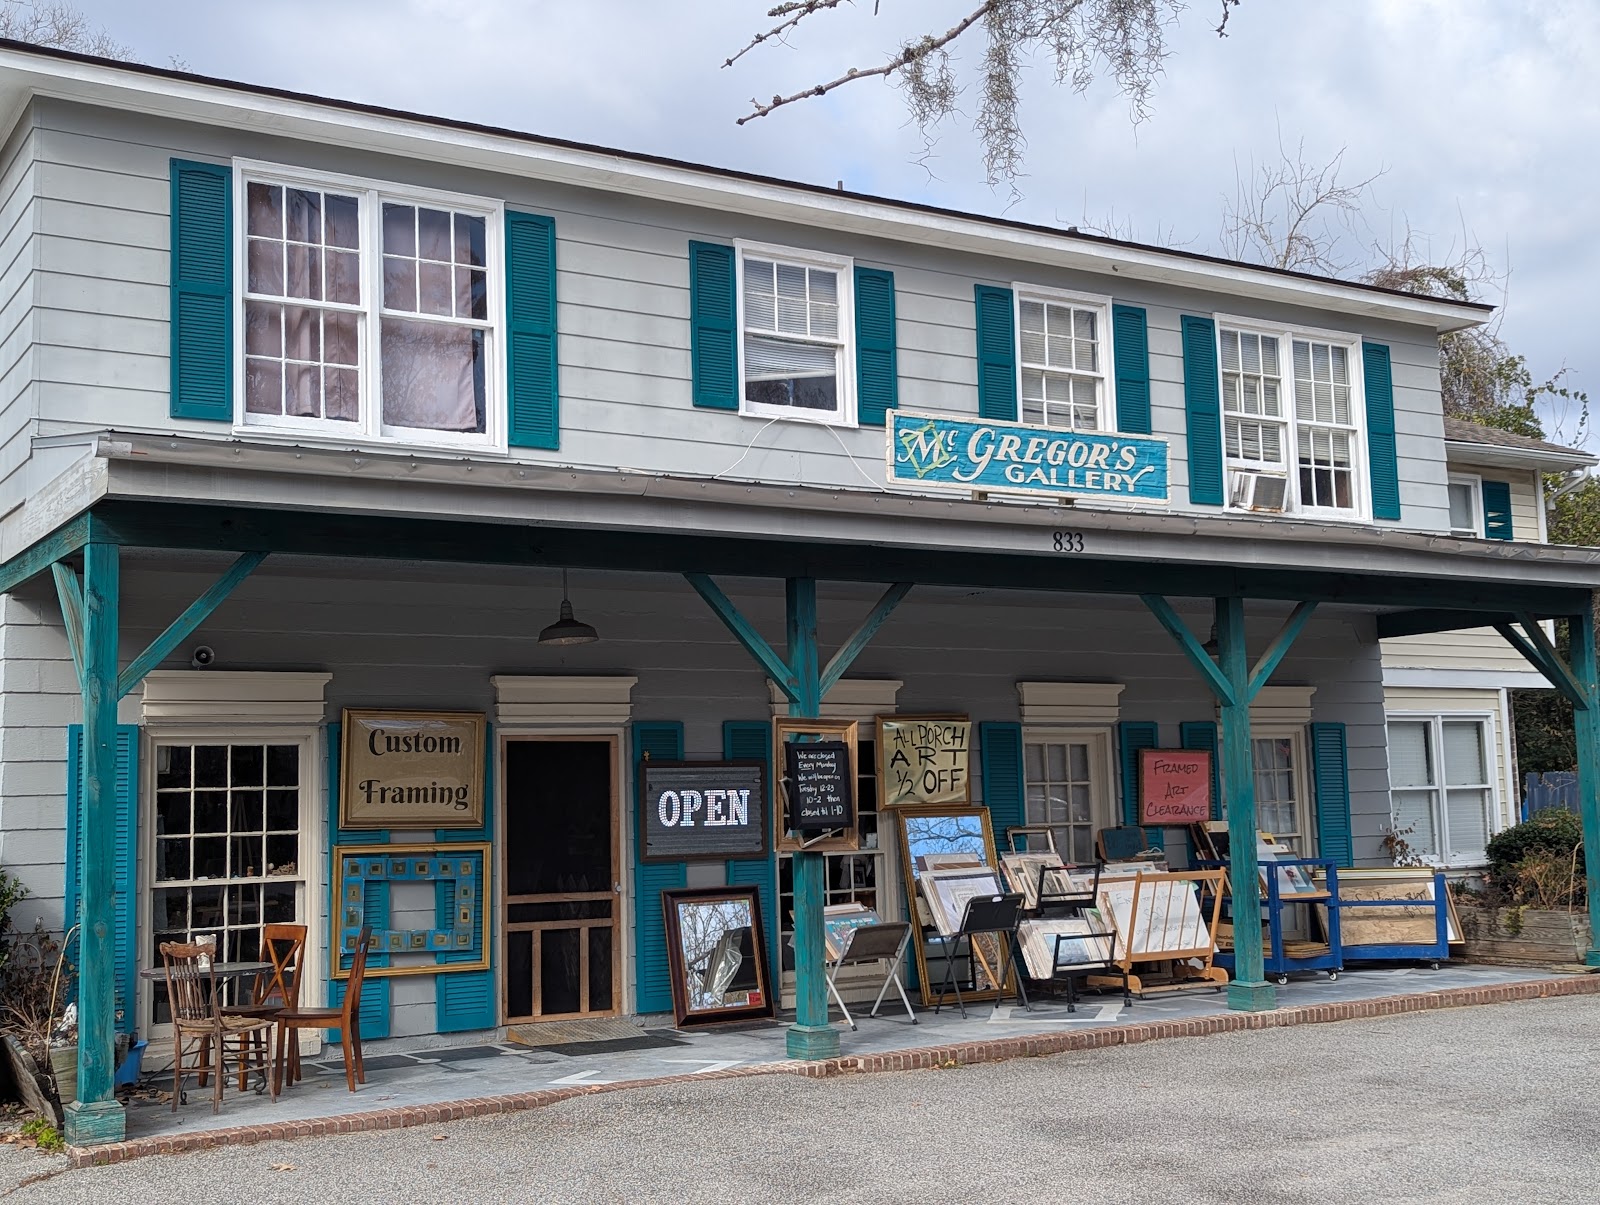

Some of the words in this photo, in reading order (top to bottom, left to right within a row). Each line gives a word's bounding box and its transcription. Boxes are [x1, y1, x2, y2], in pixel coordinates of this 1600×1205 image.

[1003, 464, 1155, 492] GALLERY
[1053, 531, 1085, 552] 833
[368, 728, 461, 756] Custom
[893, 727, 917, 749] ALL
[917, 724, 966, 748] PORCH
[797, 751, 807, 759] We
[817, 752, 835, 760] closed
[890, 746, 968, 769] ART
[797, 773, 807, 781] We
[798, 762, 815, 770] Every
[816, 761, 837, 773] Monday
[923, 768, 965, 794] OFF
[1165, 781, 1189, 800] ART
[358, 779, 469, 811] Framing
[806, 796, 821, 804] 10-2
[658, 789, 751, 827] OPEN
[801, 808, 820, 816] closed
